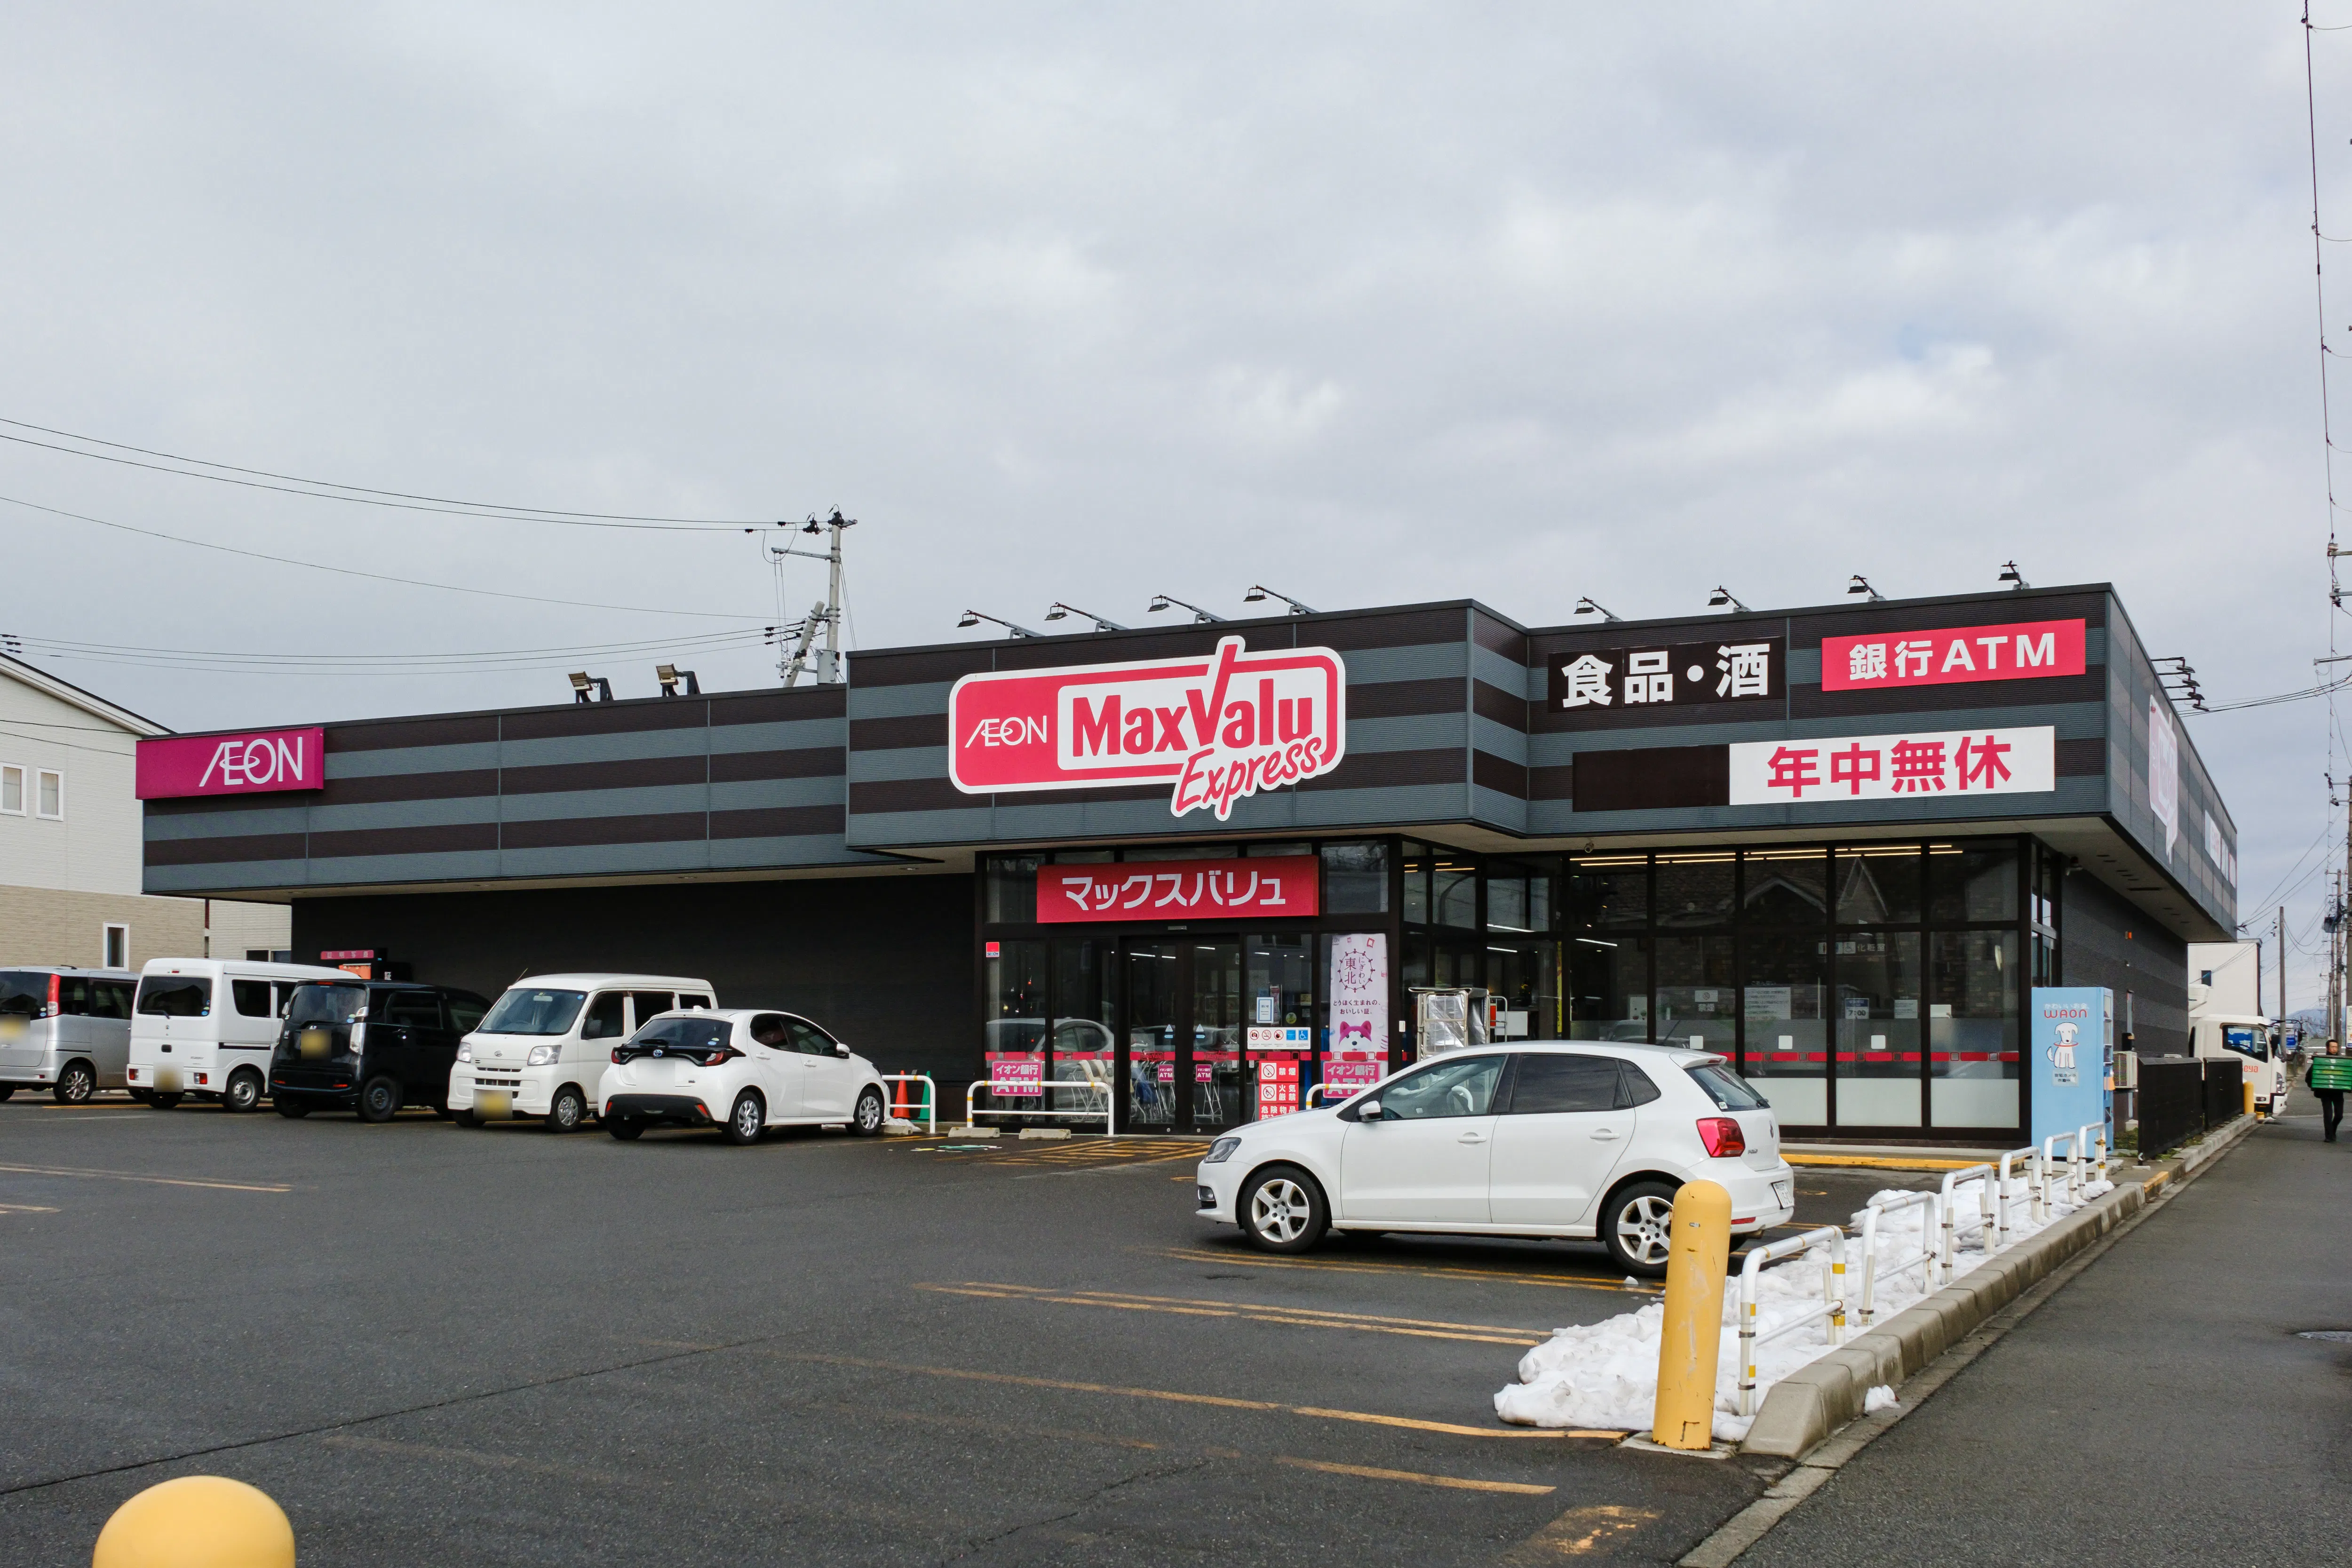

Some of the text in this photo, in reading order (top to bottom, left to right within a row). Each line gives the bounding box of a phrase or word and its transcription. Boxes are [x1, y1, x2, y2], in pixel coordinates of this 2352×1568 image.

[1073, 644, 1312, 756] MaxValu
[1768, 735, 2011, 797] 年中無休
[1176, 737, 1321, 816] Express
[1062, 871, 1286, 910] マックスバリュ
[1344, 957, 1357, 984] 東北
[996, 1065, 1038, 1075] イオン銀行
[1328, 1065, 1375, 1075] イオン銀行
[1279, 1084, 1296, 1092] 火気
[1279, 1093, 1296, 1101] 厳禁
[1261, 1106, 1296, 1114] 危険物品
